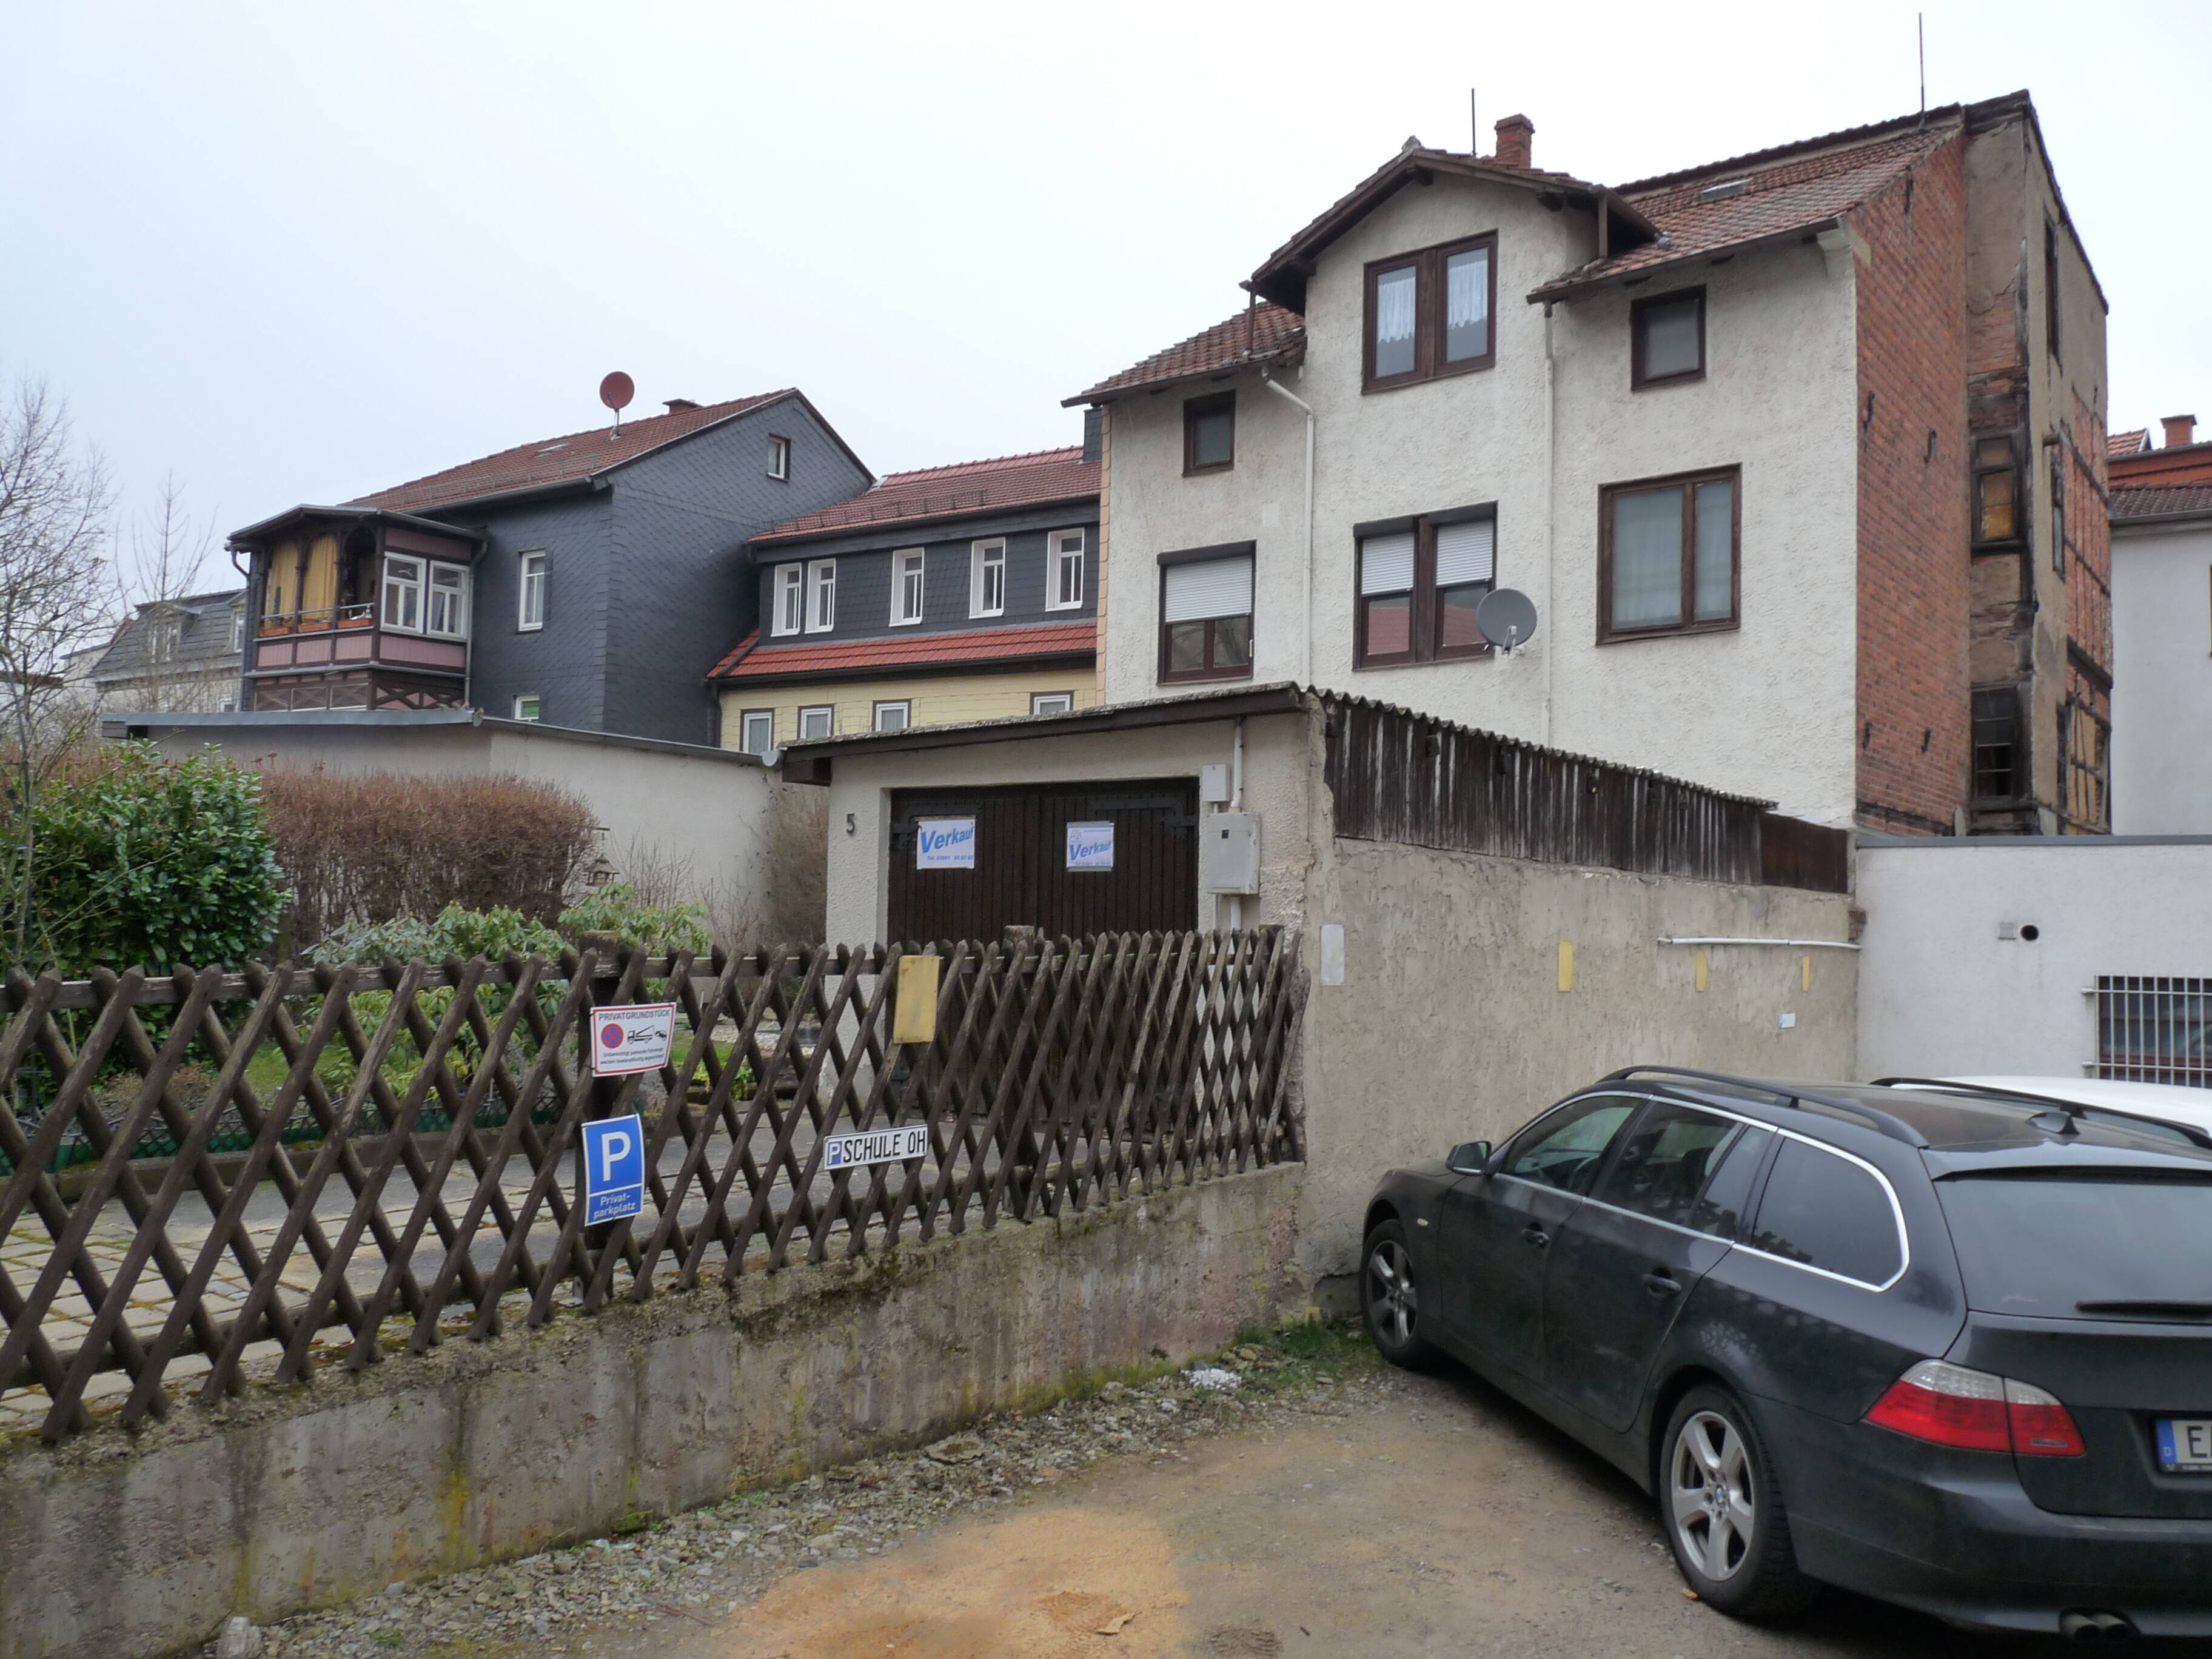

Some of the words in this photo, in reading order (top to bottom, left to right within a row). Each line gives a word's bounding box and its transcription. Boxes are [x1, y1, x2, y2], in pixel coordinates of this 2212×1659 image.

[846, 813, 855, 835] 5
[920, 826, 974, 853] Verkauf
[1070, 840, 1111, 860] Verkauf
[598, 1009, 670, 1021] PRIVATGRUNDSTÜCK
[602, 1131, 631, 1182] P
[843, 1133, 901, 1163] SCHULE
[908, 1130, 926, 1154] OH
[594, 1201, 636, 1220] parkplatz
[600, 1193, 631, 1206] Privat-
[2187, 1426, 2212, 1458] E
